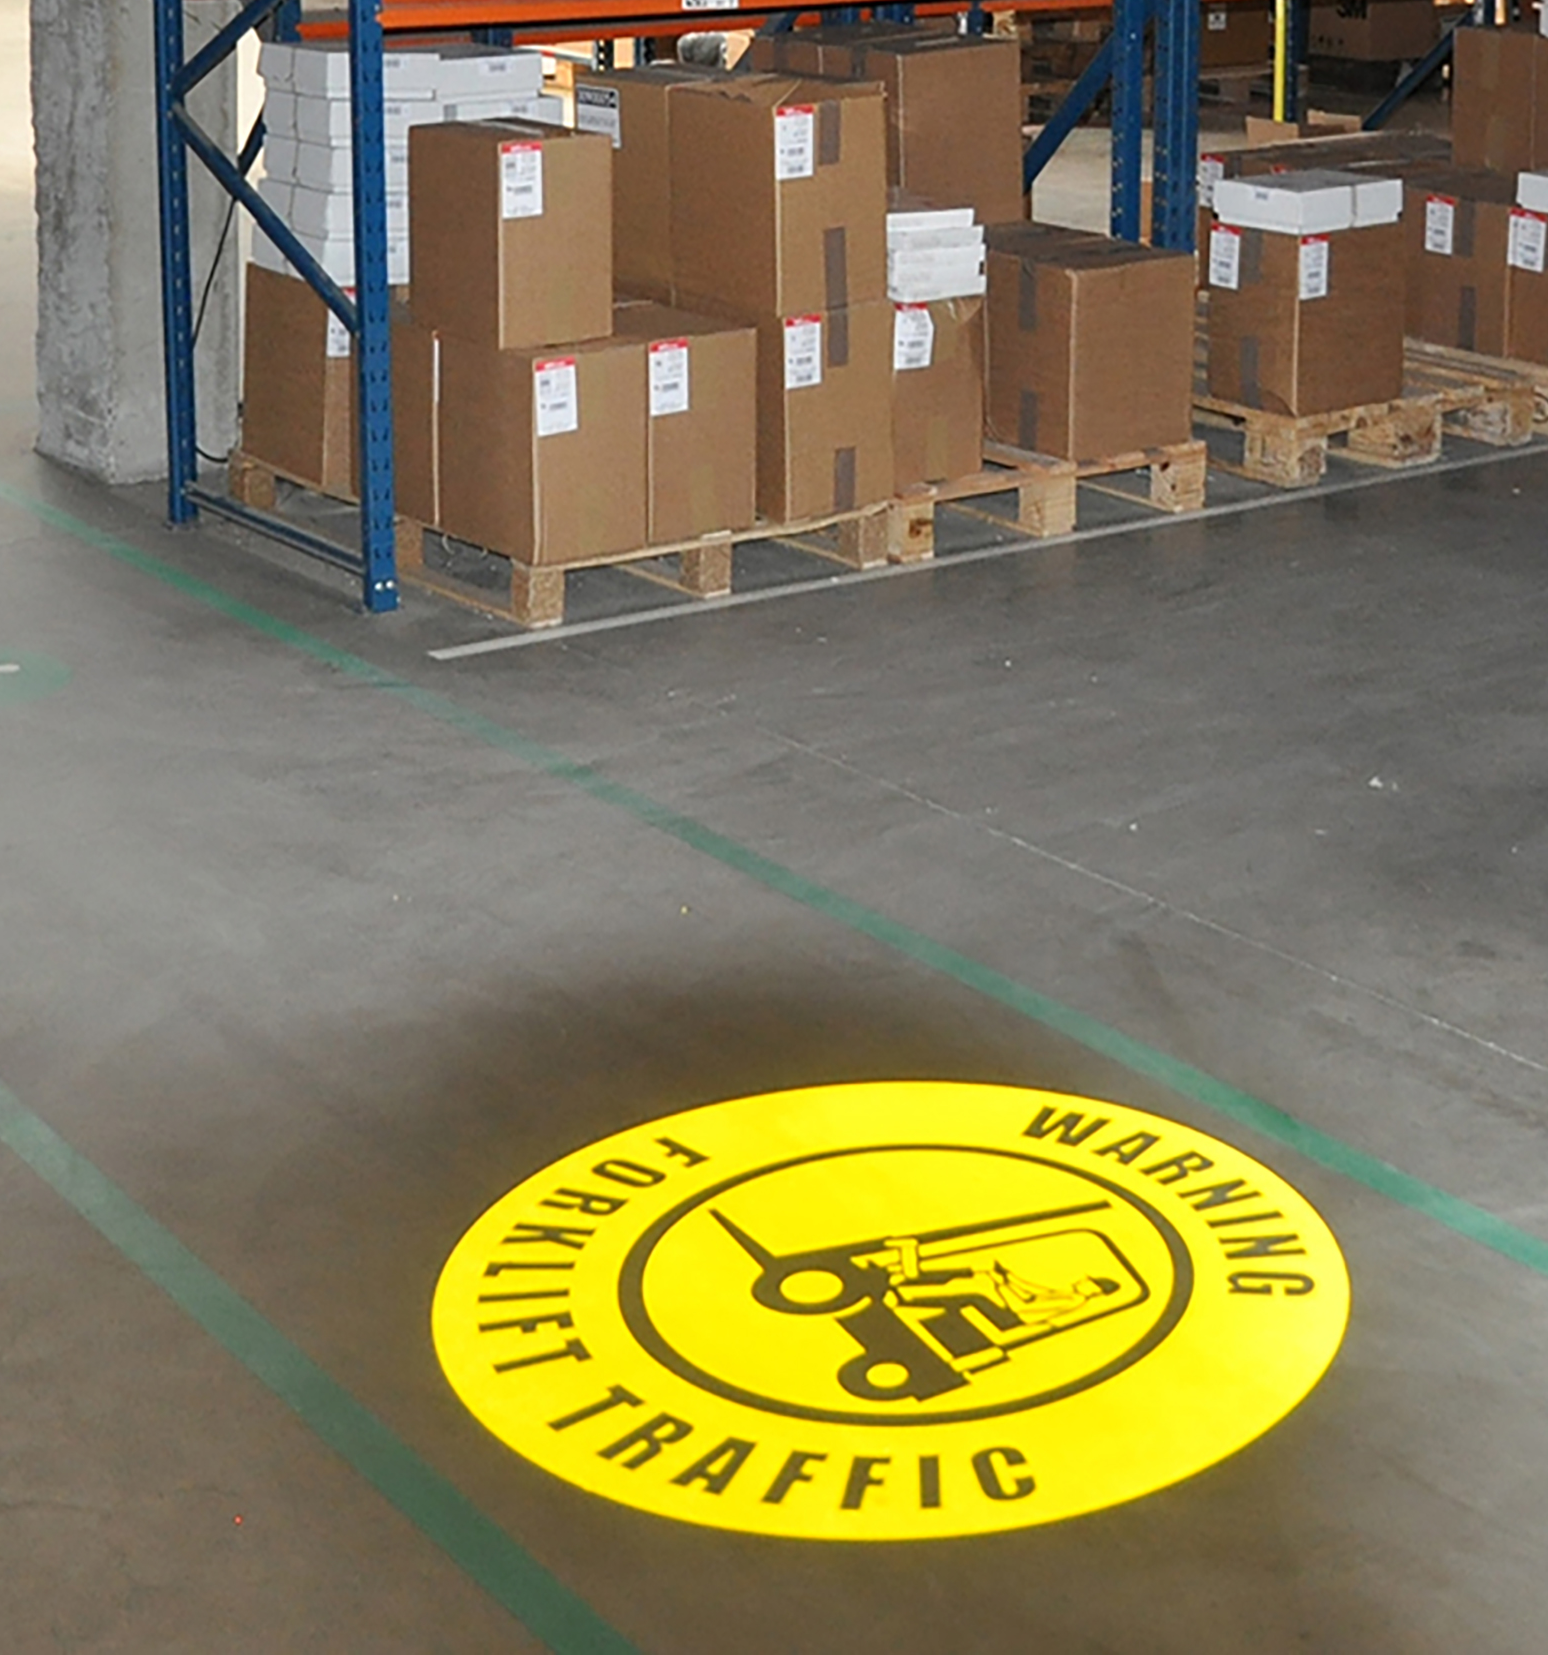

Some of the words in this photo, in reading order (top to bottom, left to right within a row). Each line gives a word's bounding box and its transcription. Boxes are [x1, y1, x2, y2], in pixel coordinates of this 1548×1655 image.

[477, 1137, 713, 1373] FORKLIFT
[1022, 1106, 1314, 1298] WARNING
[547, 1384, 1037, 1510] TRAFFIC
